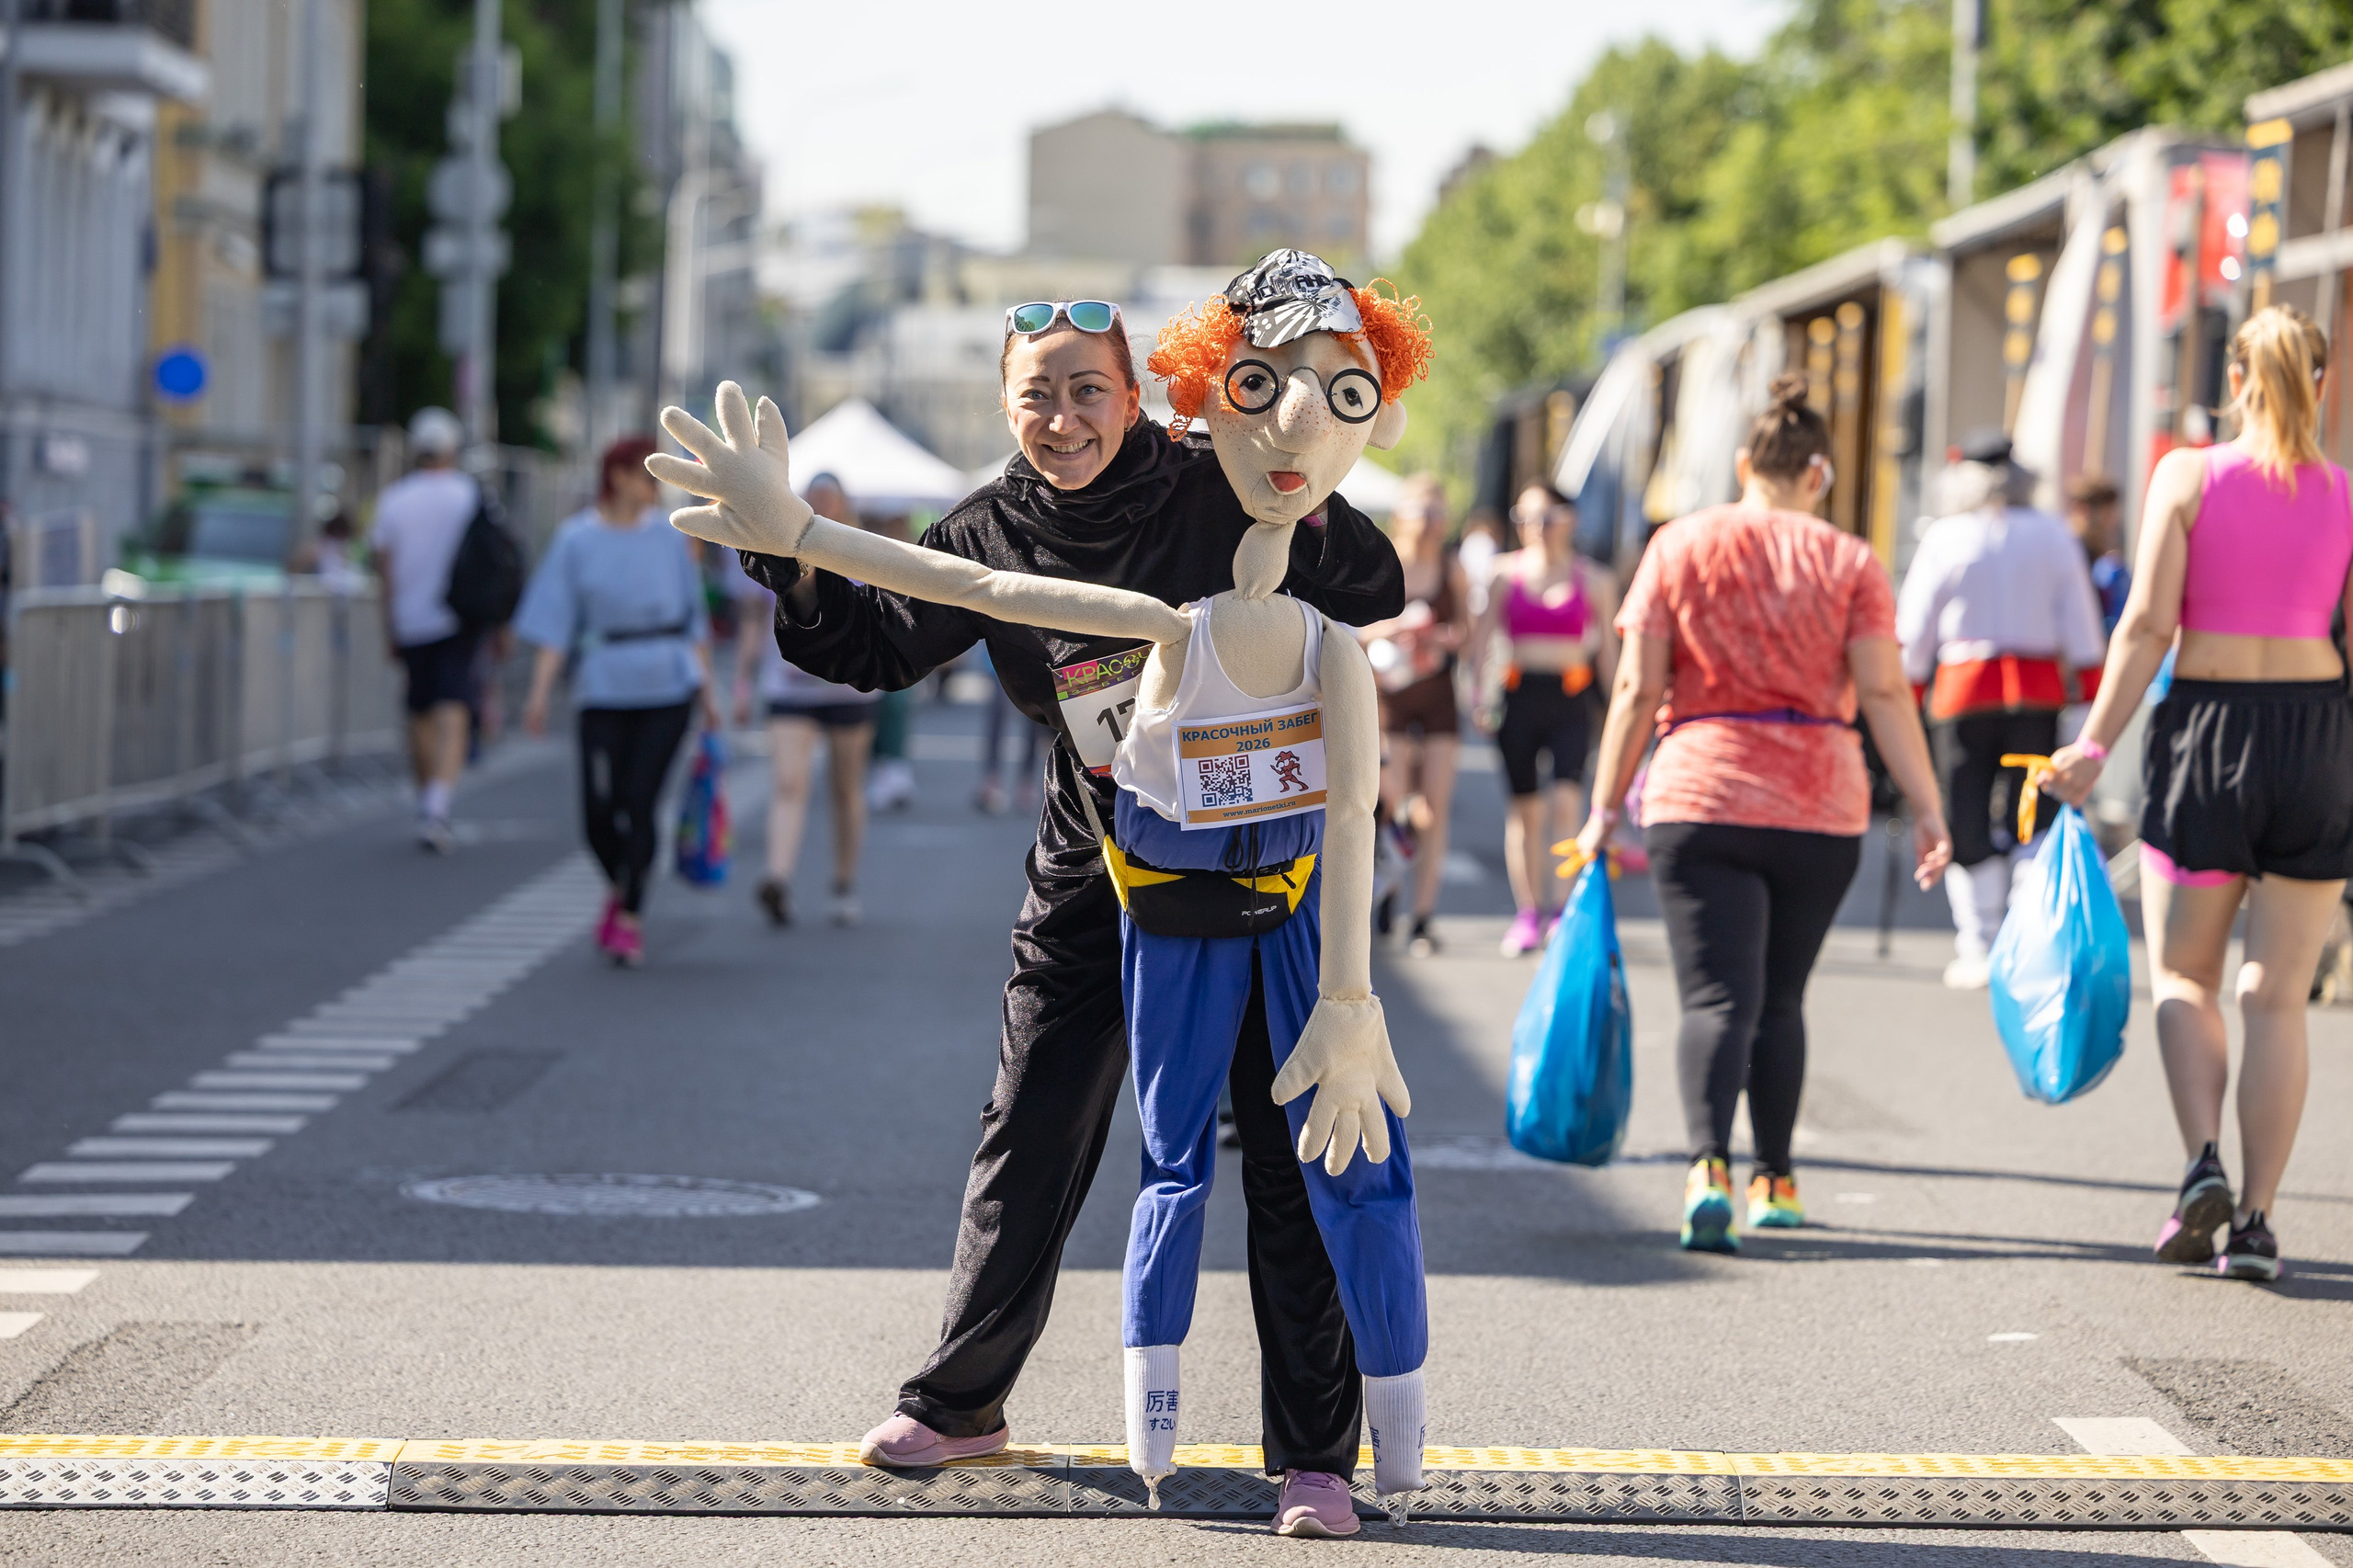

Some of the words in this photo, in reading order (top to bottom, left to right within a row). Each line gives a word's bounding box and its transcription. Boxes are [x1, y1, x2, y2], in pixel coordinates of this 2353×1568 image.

[1182, 719, 1274, 742] КРАСОЧНЫЙ
[1277, 711, 1318, 731] ЗАБЕГ
[1236, 737, 1271, 753] 2026
[1222, 800, 1296, 818] www.marionetki.ru
[1145, 1389, 1179, 1413] 厉害
[1149, 1417, 1176, 1432] すごい
